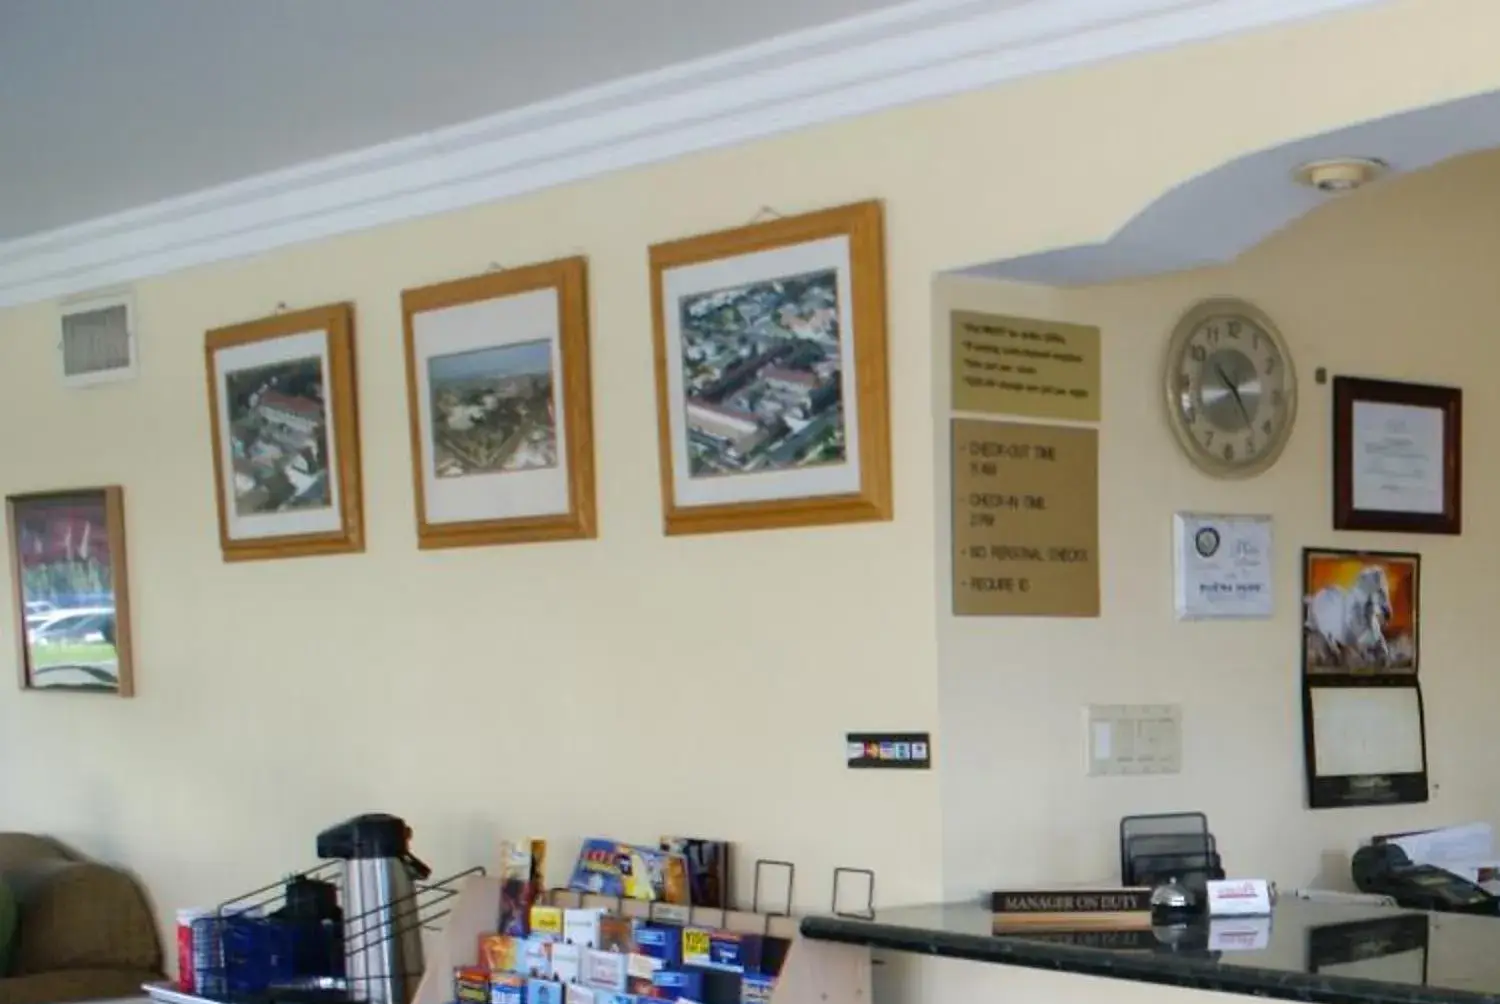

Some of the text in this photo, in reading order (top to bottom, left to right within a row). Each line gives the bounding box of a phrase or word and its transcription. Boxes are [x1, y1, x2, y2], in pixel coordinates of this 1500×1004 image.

[1006, 893, 1138, 911] MANAGER ON DUTY
